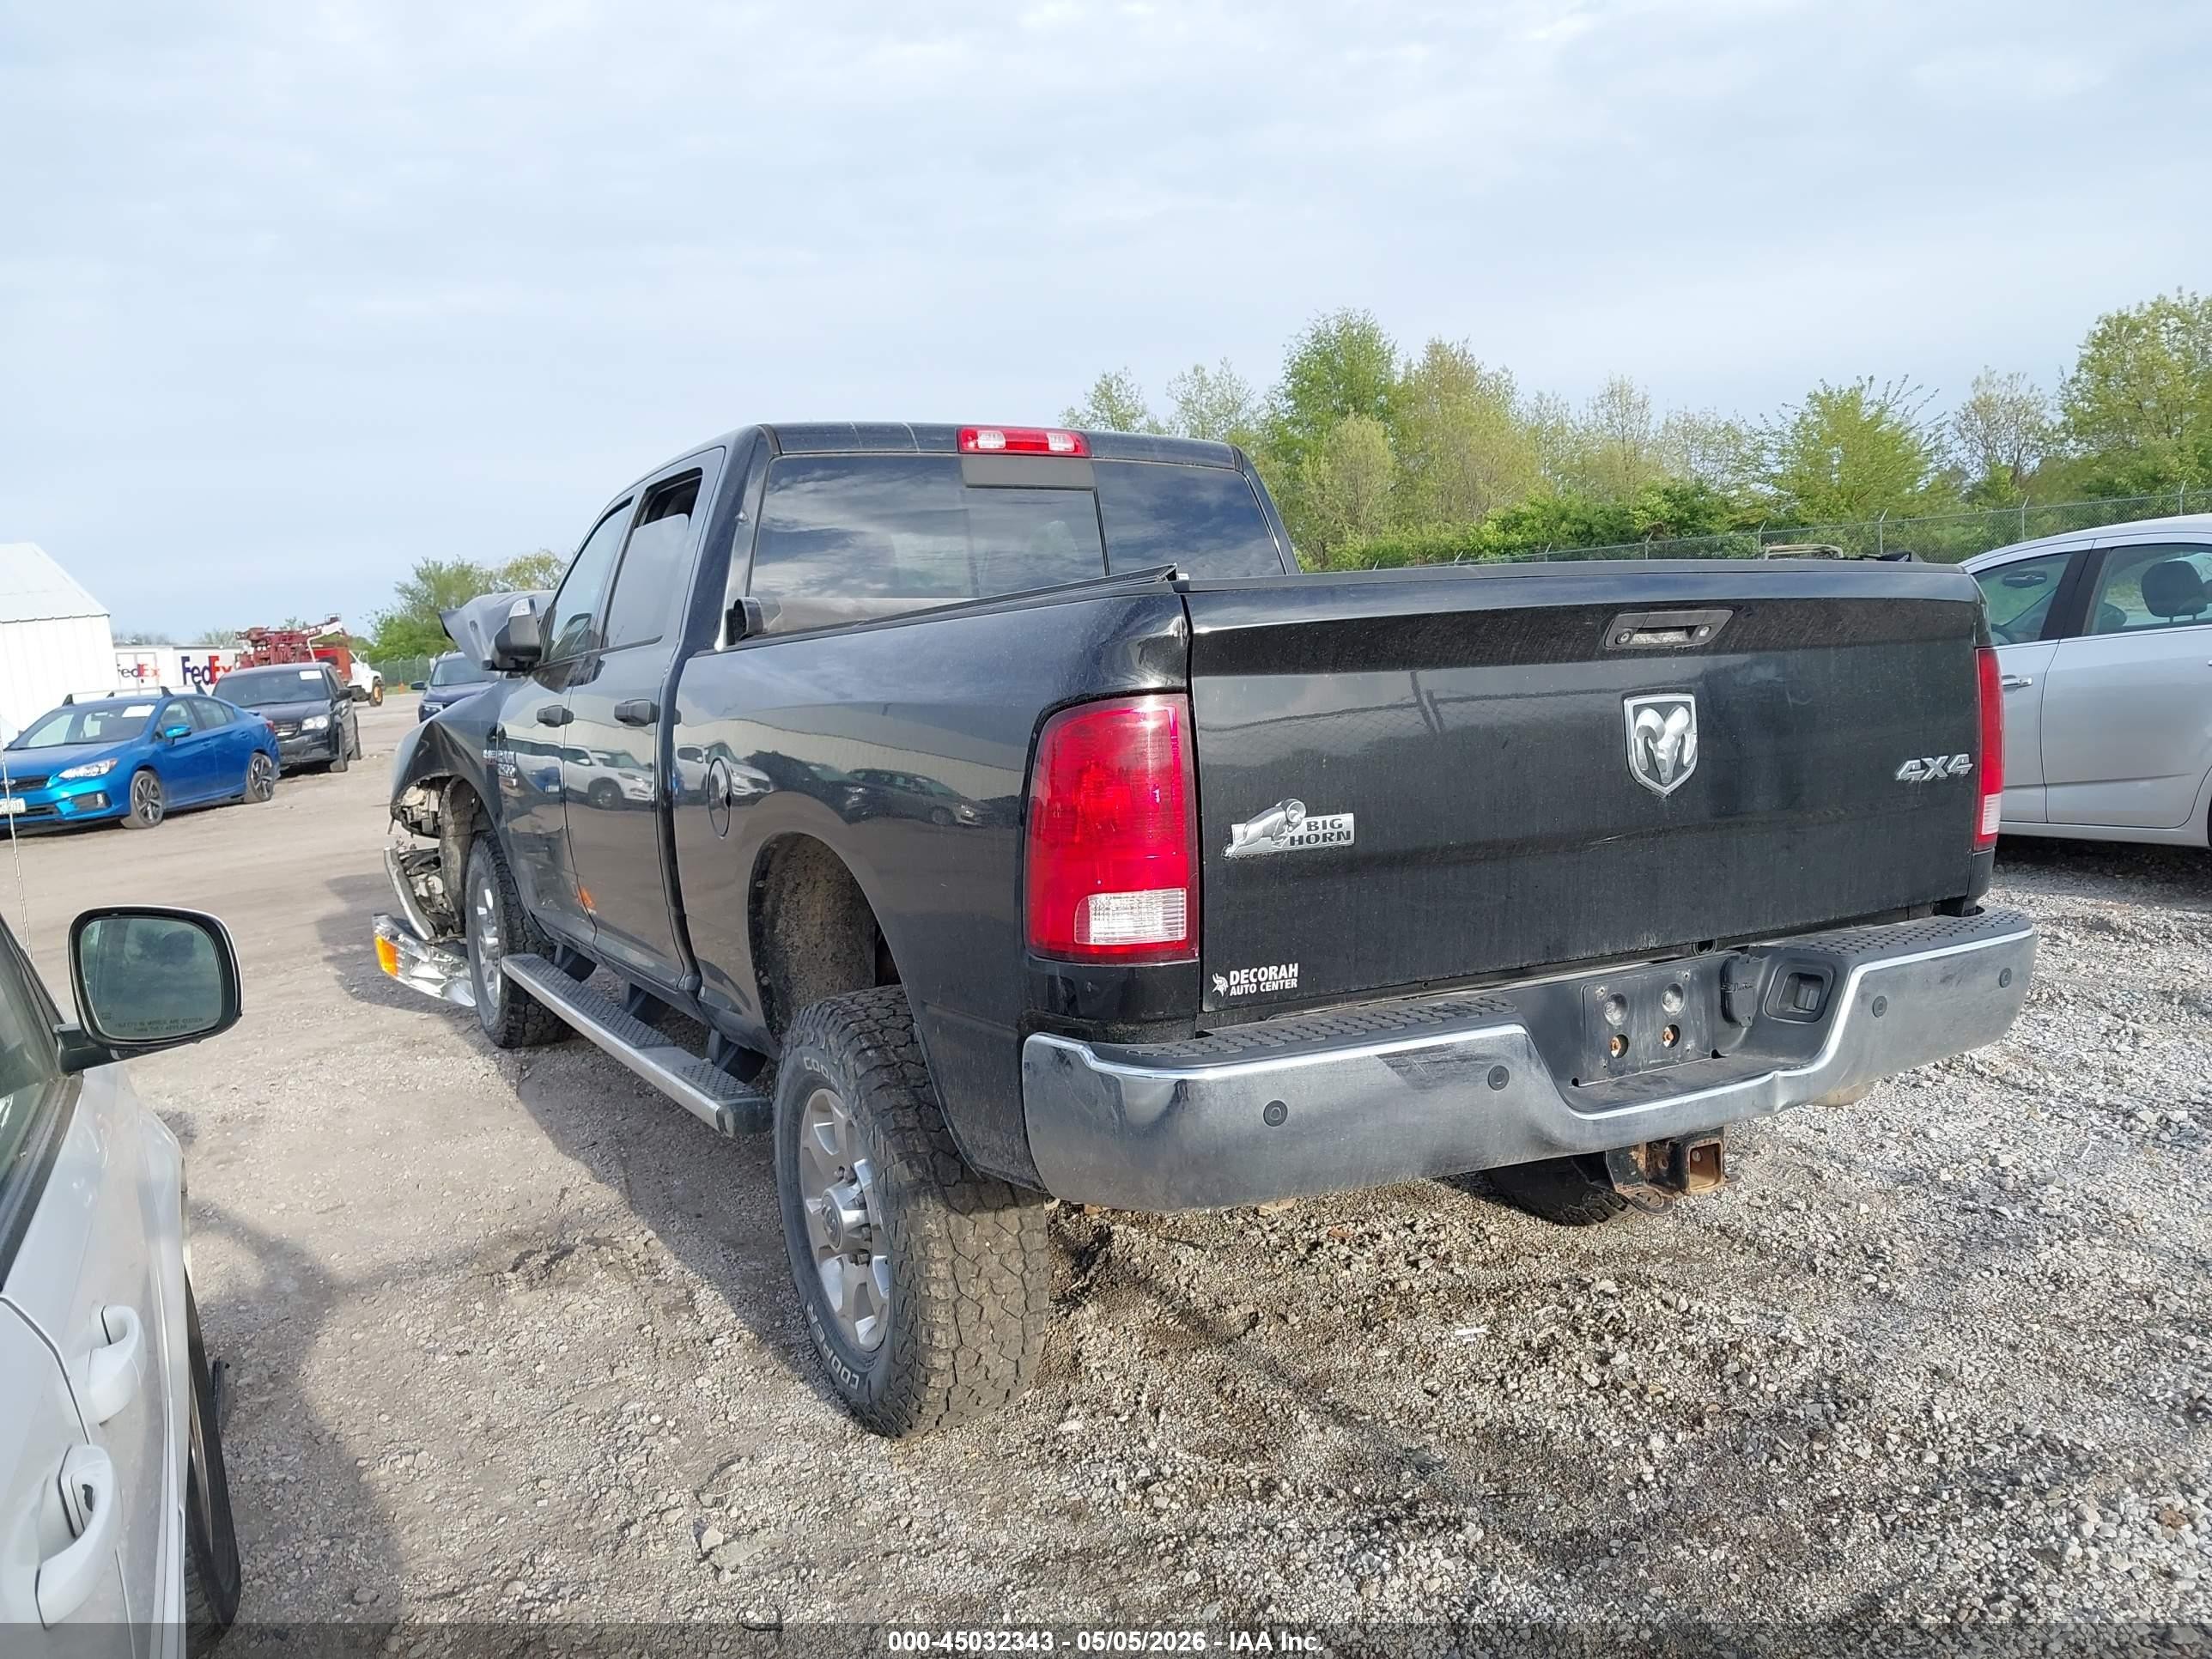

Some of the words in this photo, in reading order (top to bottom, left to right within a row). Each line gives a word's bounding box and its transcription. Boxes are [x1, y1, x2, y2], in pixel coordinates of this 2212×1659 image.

[1306, 817, 1344, 832] BIG
[1289, 830, 1352, 847] HORN
[1229, 963, 1299, 985] DECORAH
[1229, 983, 1256, 997] AUTO
[1259, 978, 1298, 994] CENTER
[806, 1301, 860, 1391] COOPER
